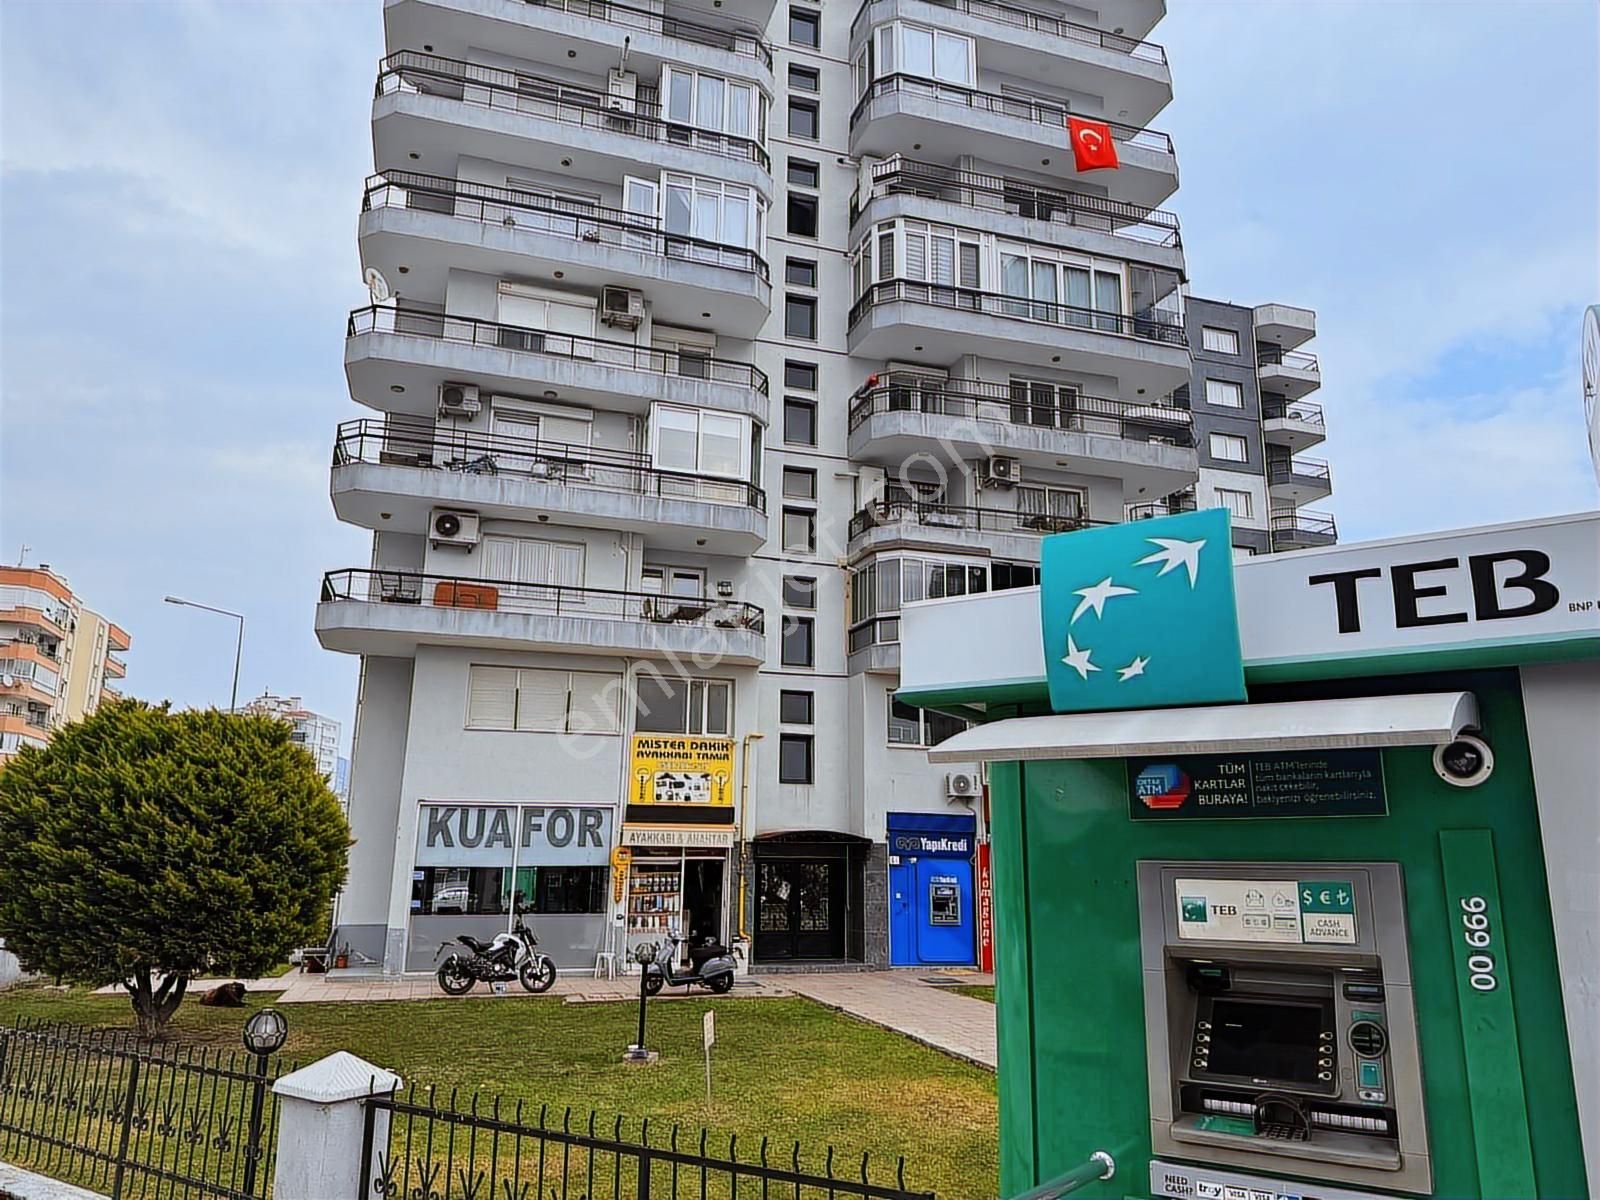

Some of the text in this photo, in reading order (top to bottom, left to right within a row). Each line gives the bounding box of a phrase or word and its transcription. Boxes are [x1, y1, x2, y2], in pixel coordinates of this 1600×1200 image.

[1309, 549, 1560, 634] TEB
[1569, 601, 1593, 612] BNP
[1217, 763, 1245, 775] TÜM
[1138, 785, 1162, 795] ATM
[1194, 779, 1246, 790] KARTLAR
[1199, 793, 1248, 805] BURAYA!
[1210, 904, 1237, 916] TEB
[1317, 919, 1341, 928] CASH
[1309, 928, 1350, 937] ADVANCE
[1164, 1174, 1188, 1186] NEED
[1165, 1184, 1193, 1196] CASH?
